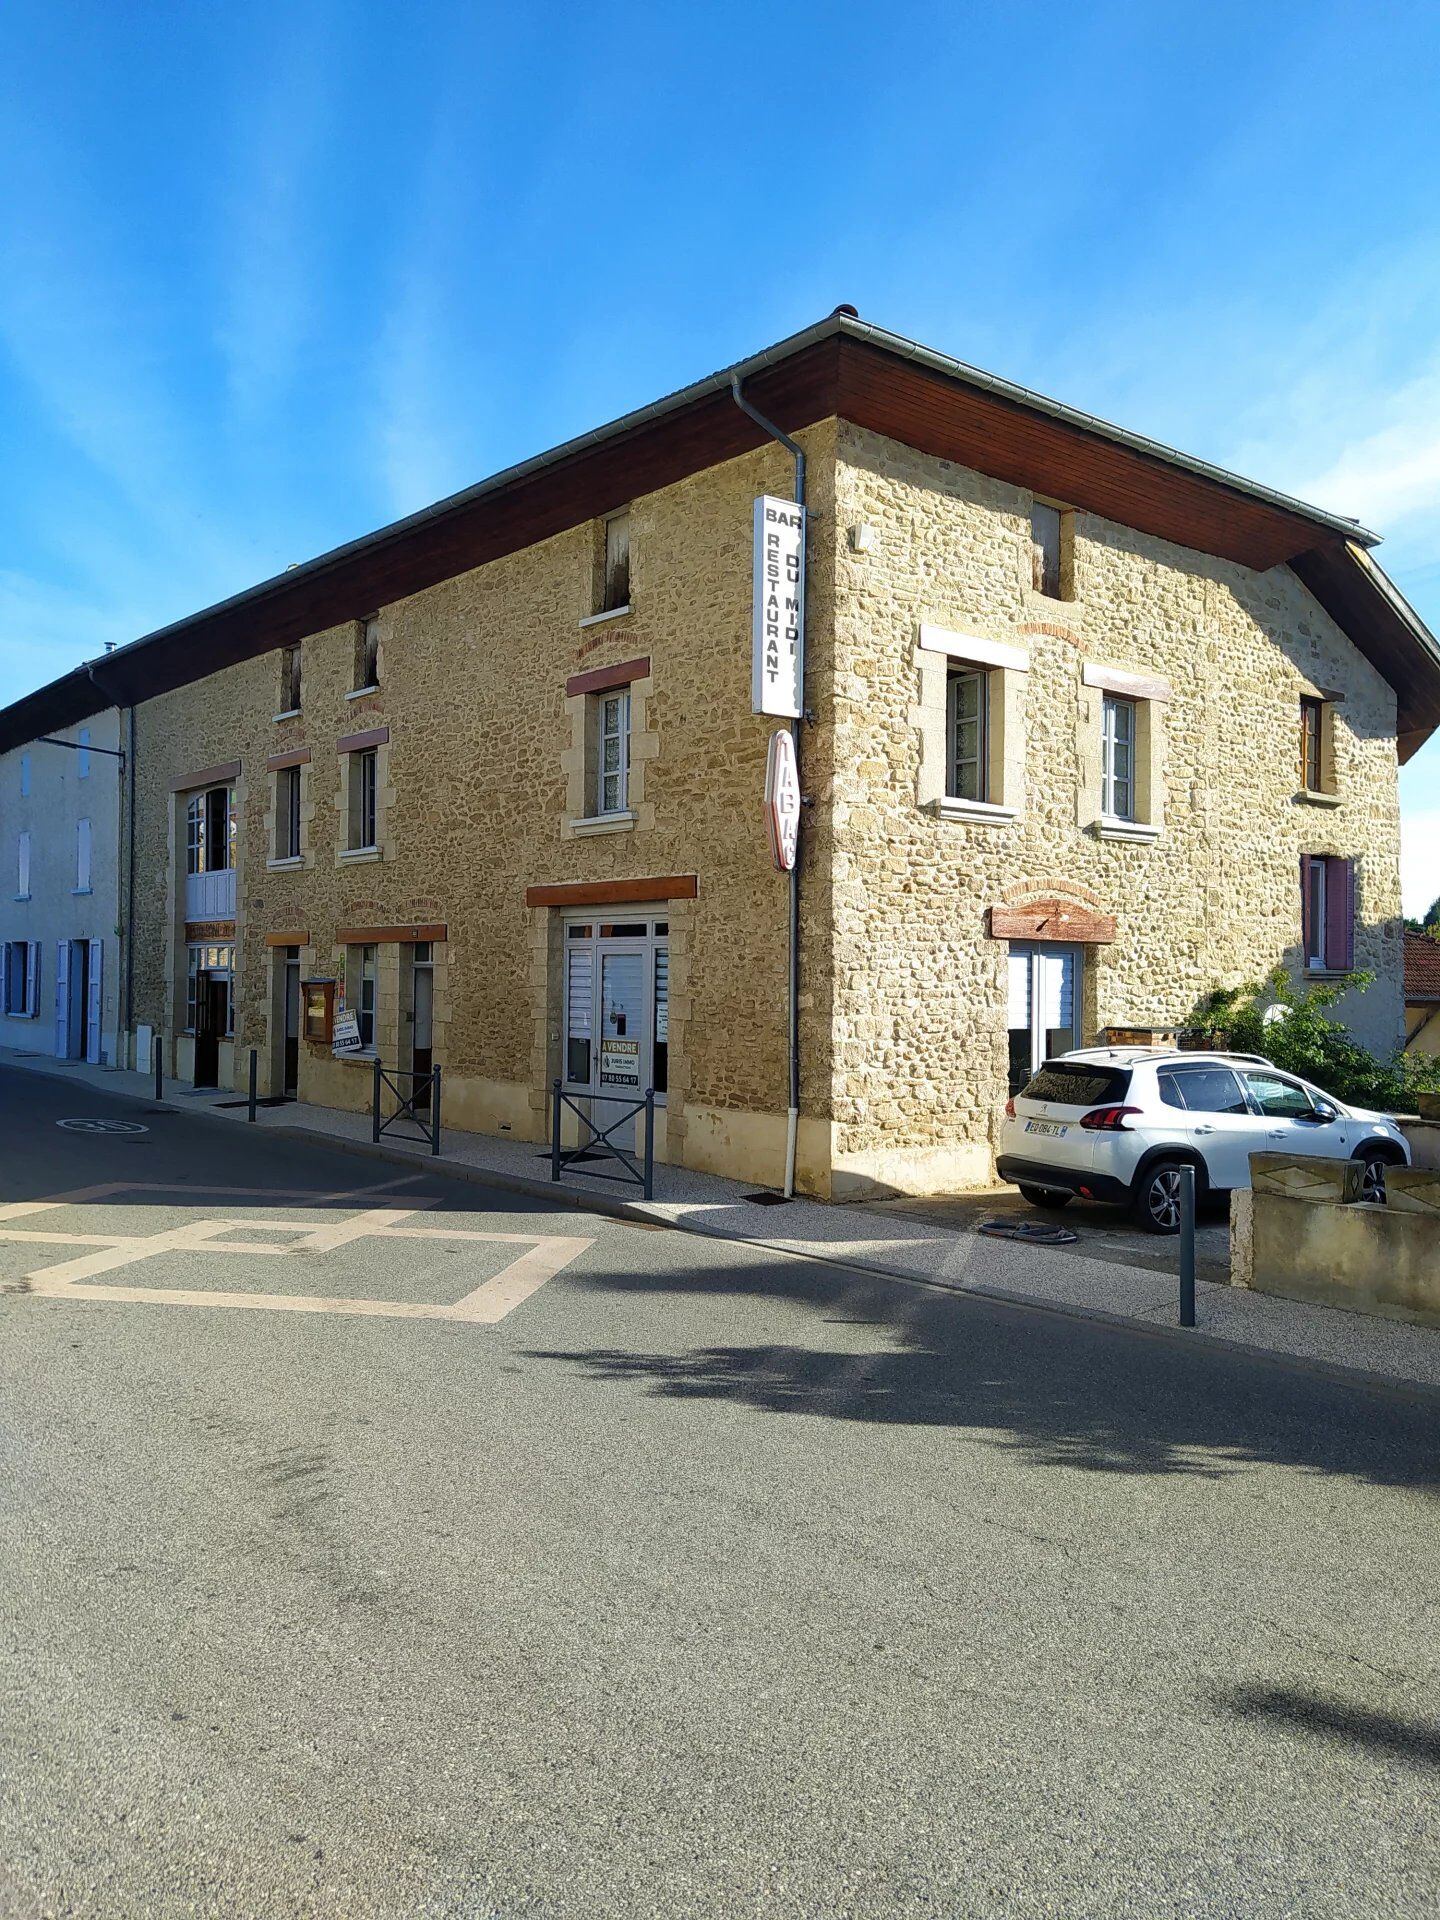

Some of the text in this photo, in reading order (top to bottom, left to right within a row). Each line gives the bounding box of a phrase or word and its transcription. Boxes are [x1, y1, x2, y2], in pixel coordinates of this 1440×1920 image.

[766, 508, 802, 530] BAR
[767, 533, 780, 683] RESTAURANT
[785, 554, 800, 655] DU MIDI
[780, 735, 796, 866] TABAC
[607, 1042, 636, 1053] VENDRE
[616, 1075, 622, 1083] 55
[71, 1121, 131, 1131] 30
